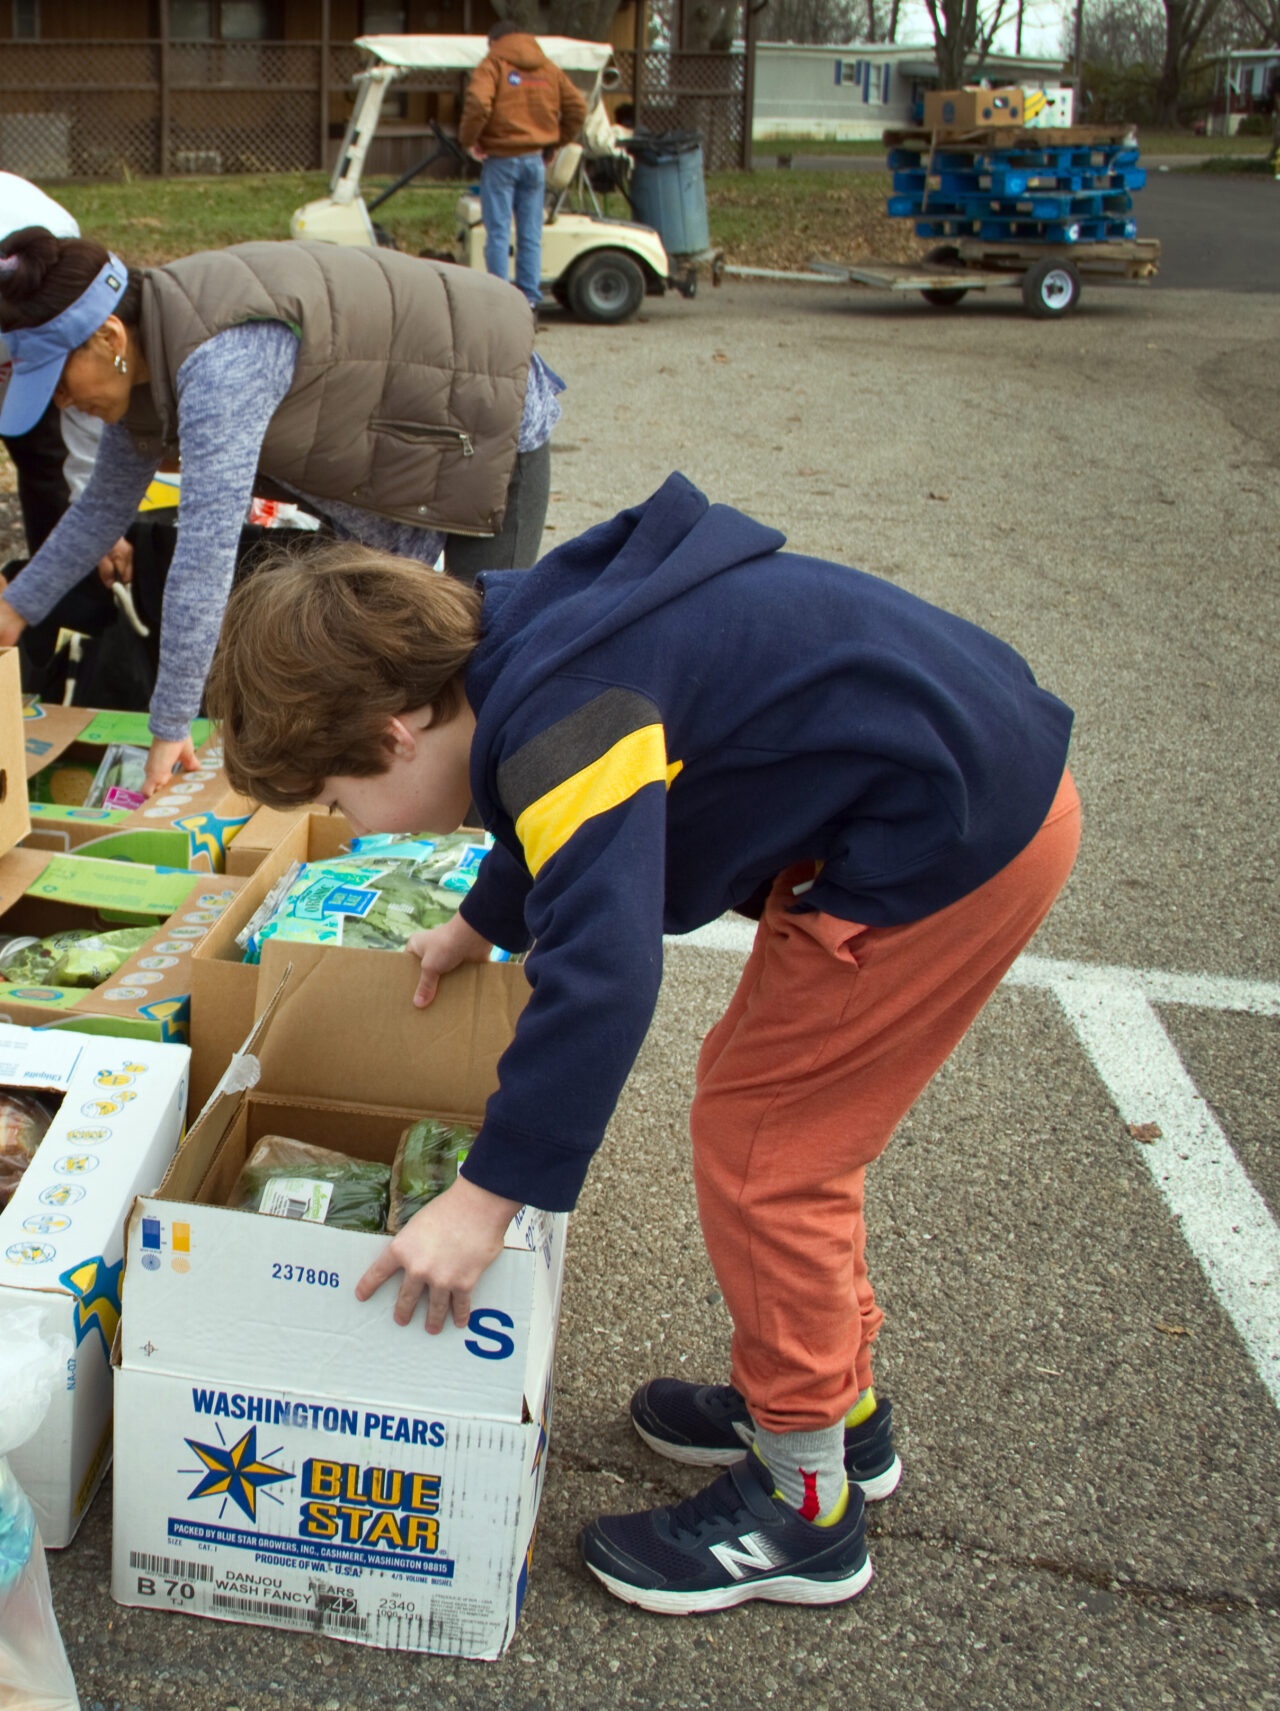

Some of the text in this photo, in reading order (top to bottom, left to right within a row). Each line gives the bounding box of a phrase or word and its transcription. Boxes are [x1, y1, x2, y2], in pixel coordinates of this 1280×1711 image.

[271, 1262, 340, 1289] 237806
[464, 1307, 515, 1361] S
[192, 1387, 446, 1448] WASHINGTON PEARS
[300, 1457, 442, 1515] BLUE
[298, 1501, 440, 1555] STAR
[167, 1537, 183, 1547] SIZE
[173, 1522, 204, 1537] PACKED
[205, 1529, 216, 1539] BY
[217, 1530, 236, 1543] BLUE
[237, 1534, 257, 1546] STAR
[258, 1537, 300, 1554] GROWERS,
[320, 1547, 367, 1564] CASHMERE,
[368, 1554, 422, 1571] WASHINGTON
[255, 1553, 297, 1568] PRODUCE
[298, 1559, 311, 1570] OF
[137, 1576, 195, 1600] B 70
[215, 1579, 312, 1604] WASH FANCY
[225, 1570, 355, 1598] DANJOU PEARS
[405, 1574, 428, 1584] VOLUME
[379, 1597, 416, 1613] 2340
